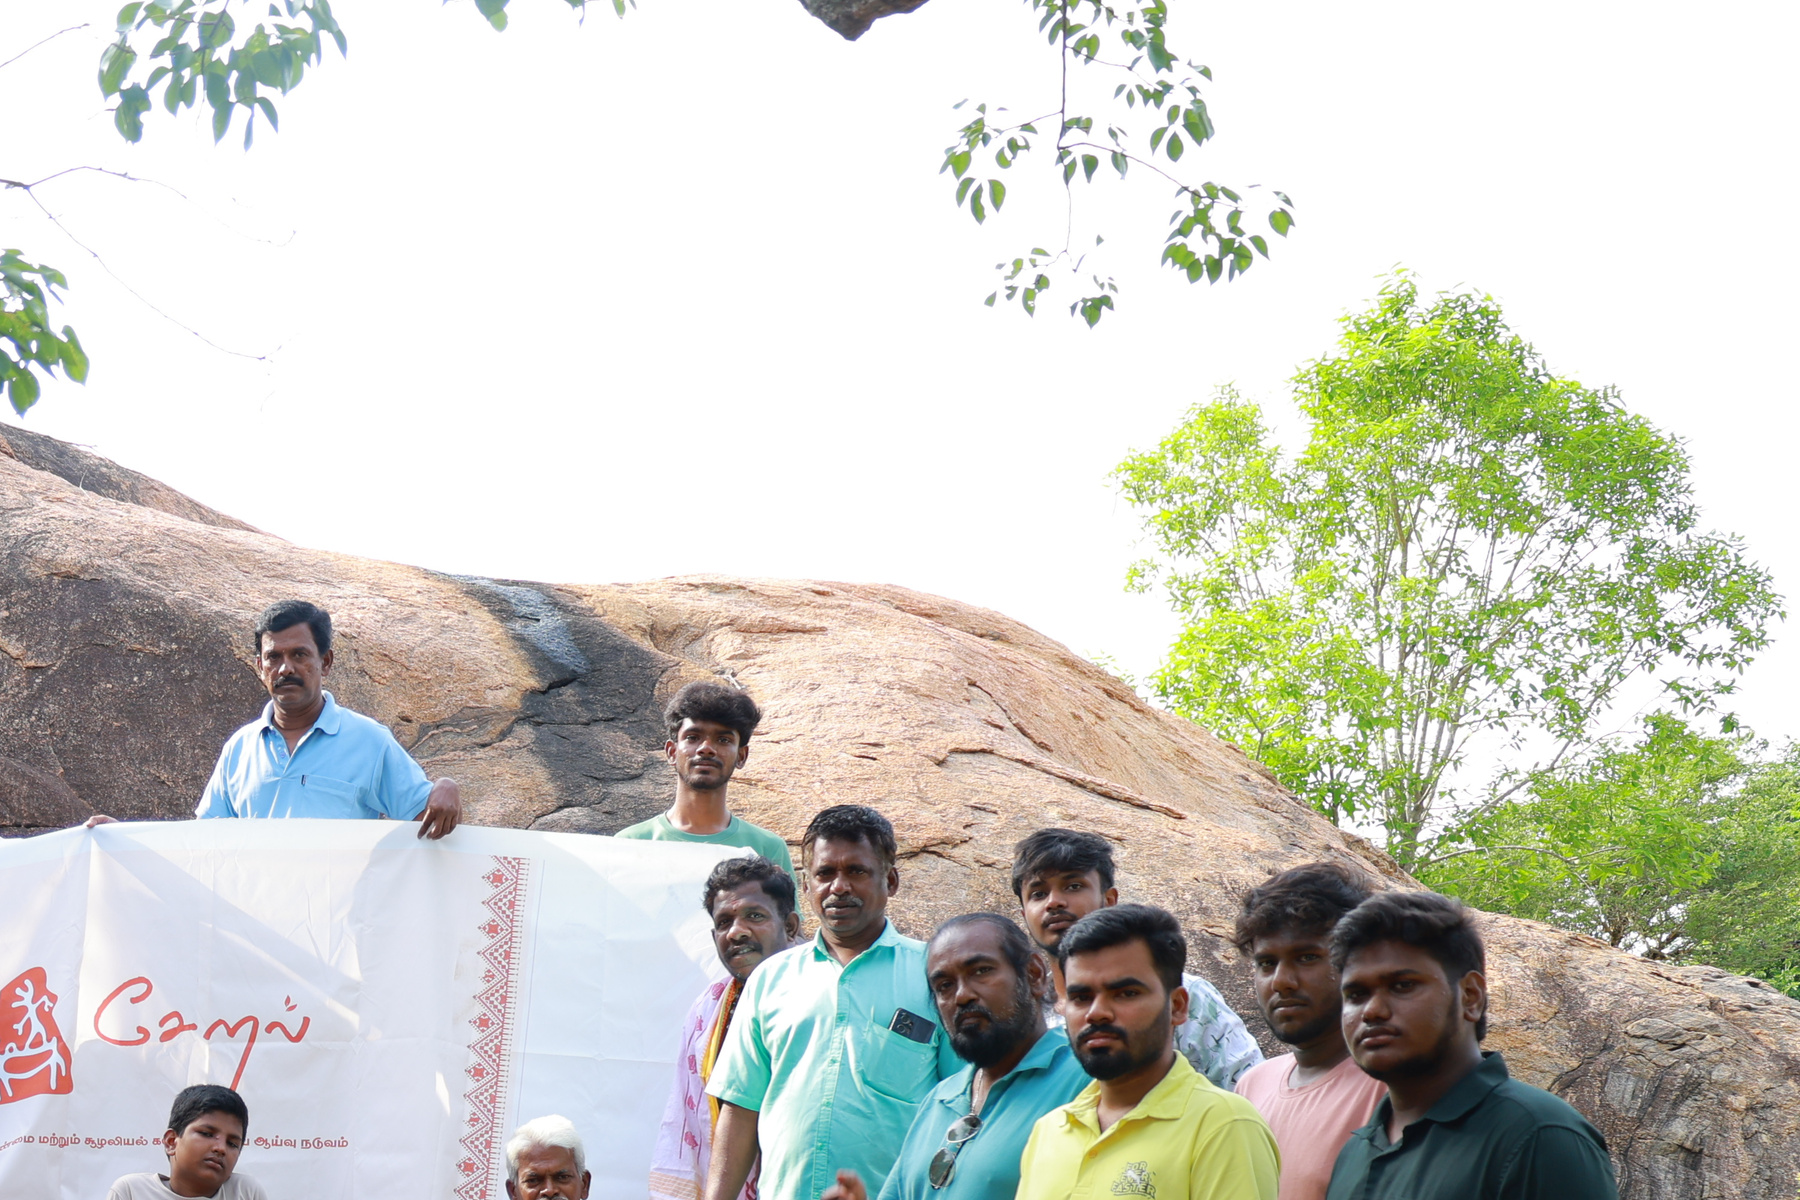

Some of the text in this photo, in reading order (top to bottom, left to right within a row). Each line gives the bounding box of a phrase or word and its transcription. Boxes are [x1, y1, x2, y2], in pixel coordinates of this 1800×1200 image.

[39, 1132, 81, 1148] மற்றும்
[84, 1135, 148, 1149] சூழலியல்
[254, 1135, 297, 1149] ஆய்வு
[300, 1136, 349, 1150] நடுவம்
[1126, 1161, 1148, 1171] FOR
